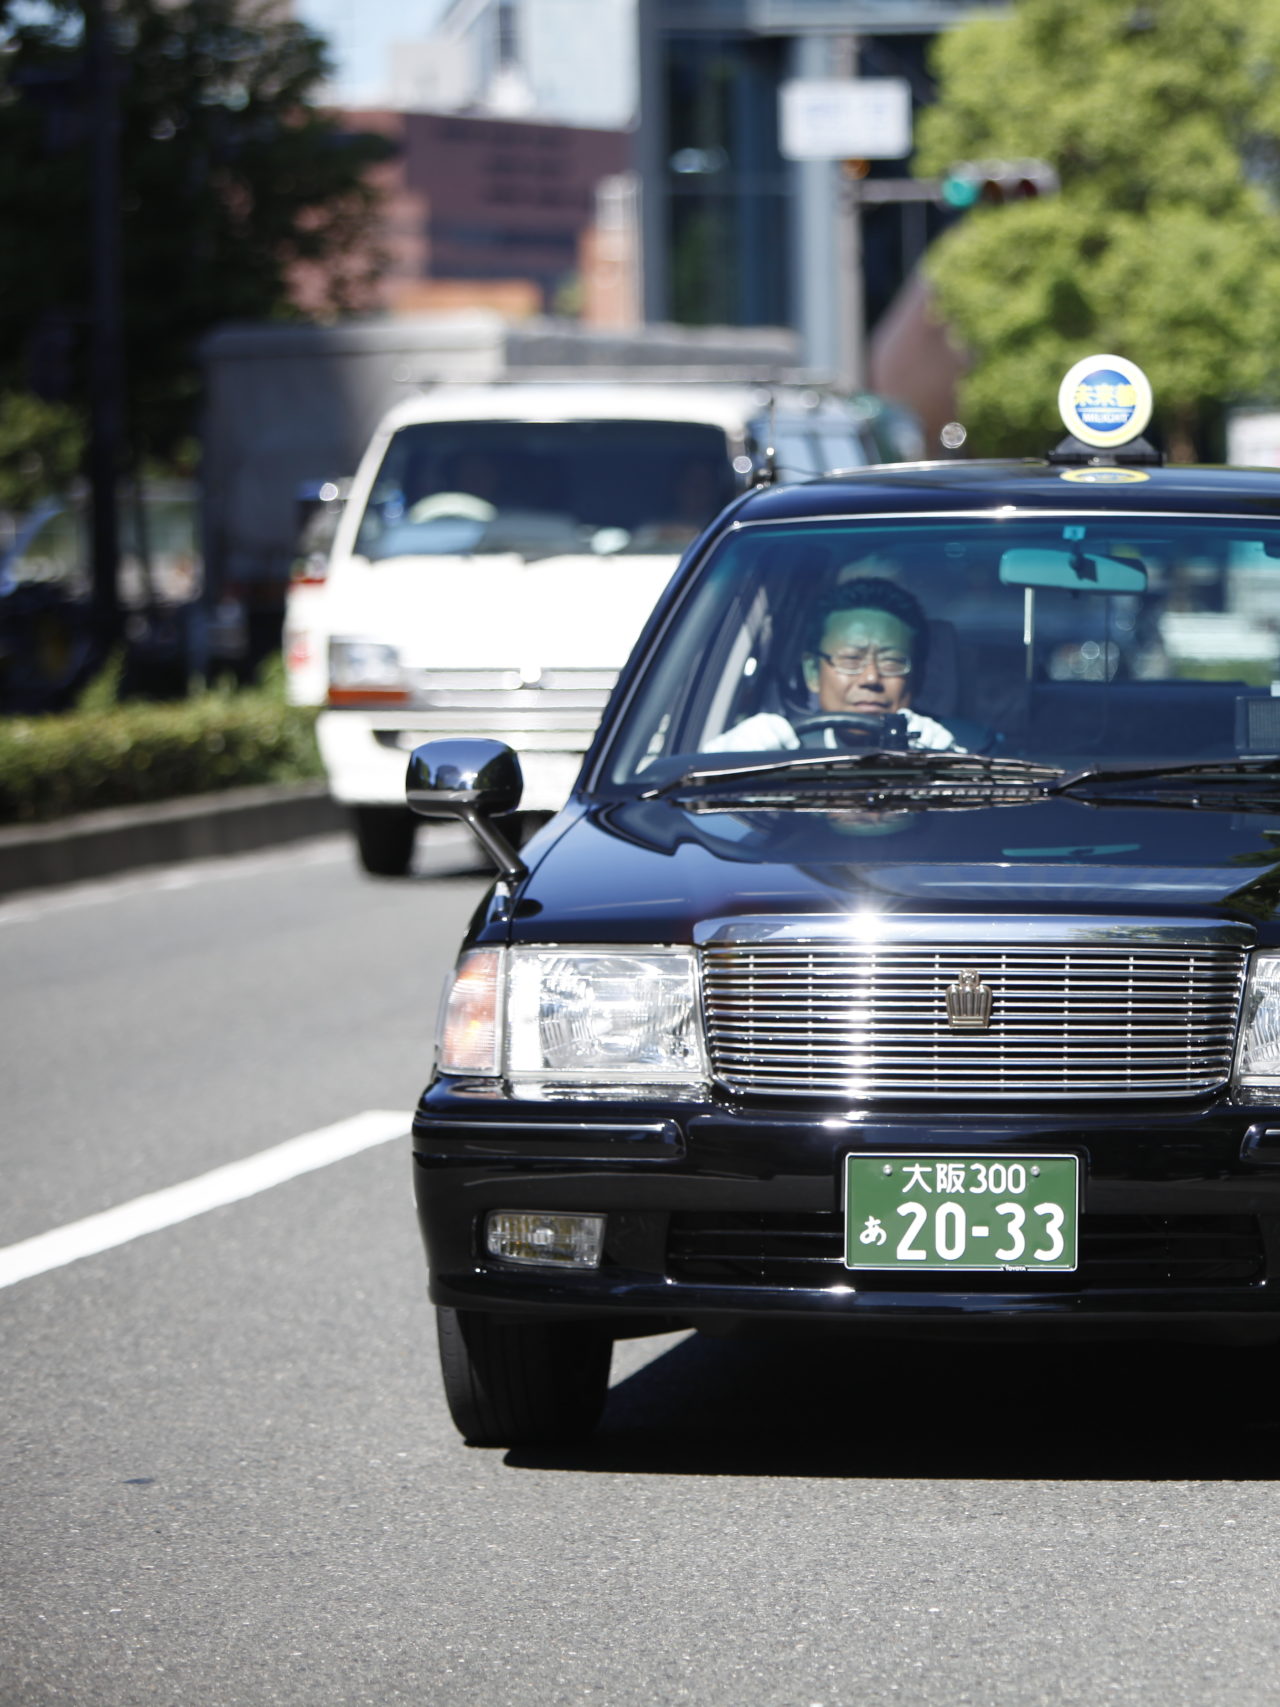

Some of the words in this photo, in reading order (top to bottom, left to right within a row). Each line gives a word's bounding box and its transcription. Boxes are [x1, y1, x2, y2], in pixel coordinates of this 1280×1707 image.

[902, 1163, 1026, 1194] 大阪300
[859, 1215, 887, 1246] あ
[896, 1201, 1065, 1261] 20-33
